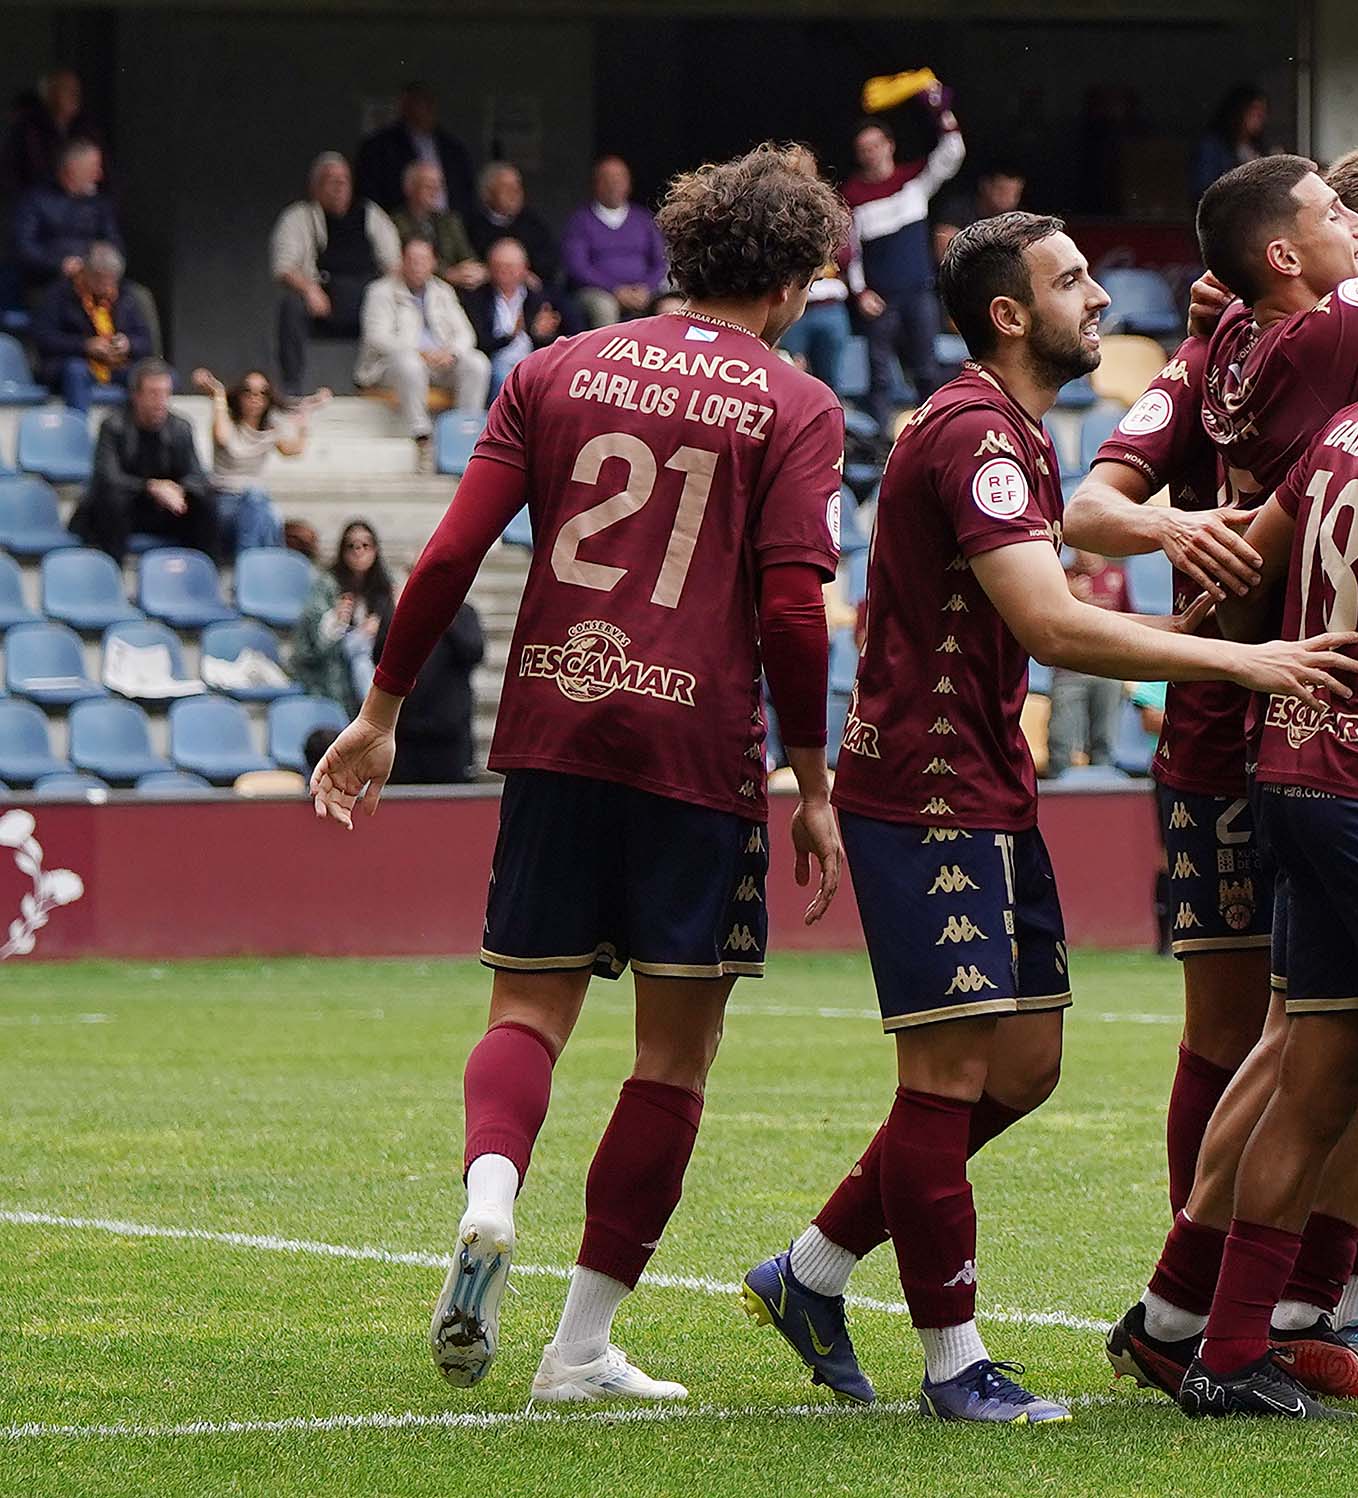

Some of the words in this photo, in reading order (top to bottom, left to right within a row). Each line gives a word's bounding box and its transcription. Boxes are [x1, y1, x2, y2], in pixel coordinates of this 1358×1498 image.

[568, 368, 681, 418] CARLOS
[684, 389, 775, 441] LOPEZ
[551, 432, 720, 609] 21
[568, 620, 632, 648] CONSERVAS
[519, 645, 697, 707] PESCAMAR
